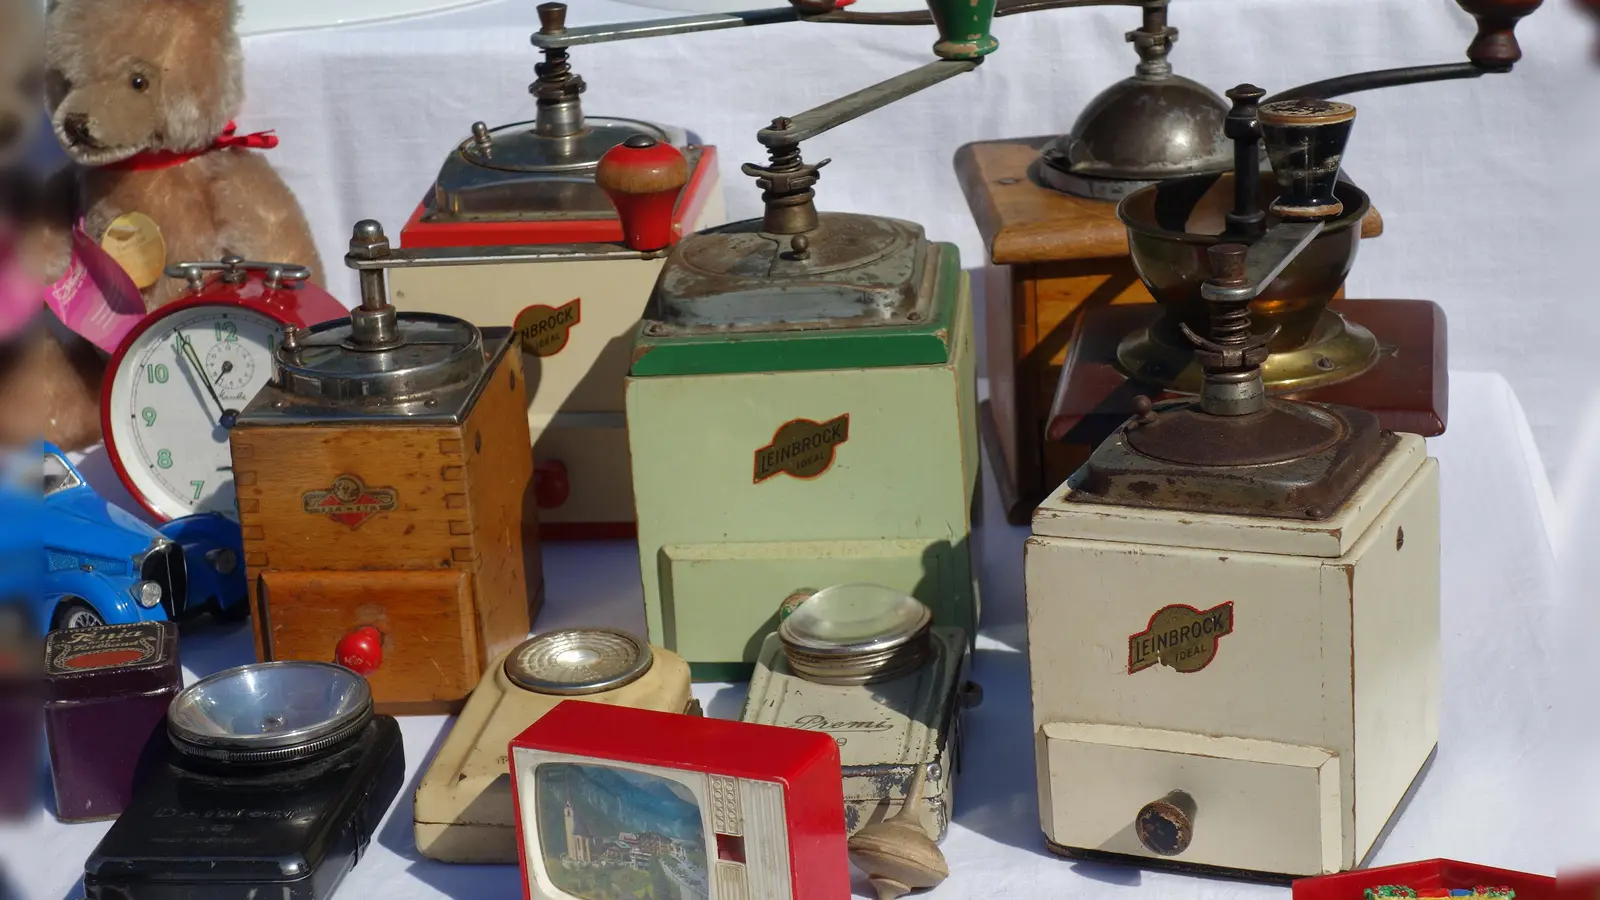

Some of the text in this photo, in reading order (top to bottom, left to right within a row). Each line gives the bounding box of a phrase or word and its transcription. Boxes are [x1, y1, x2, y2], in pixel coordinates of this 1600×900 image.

[215, 320, 239, 342] 12
[521, 306, 573, 339] NBROCK
[147, 363, 169, 384] 10
[141, 406, 157, 428] 9
[157, 449, 173, 469] 8
[761, 424, 841, 474] LEINBROCK
[796, 452, 824, 470] IDEAL
[190, 480, 205, 500] 7
[1135, 612, 1224, 663] LEINBROCK
[1175, 643, 1207, 663] IDEAL
